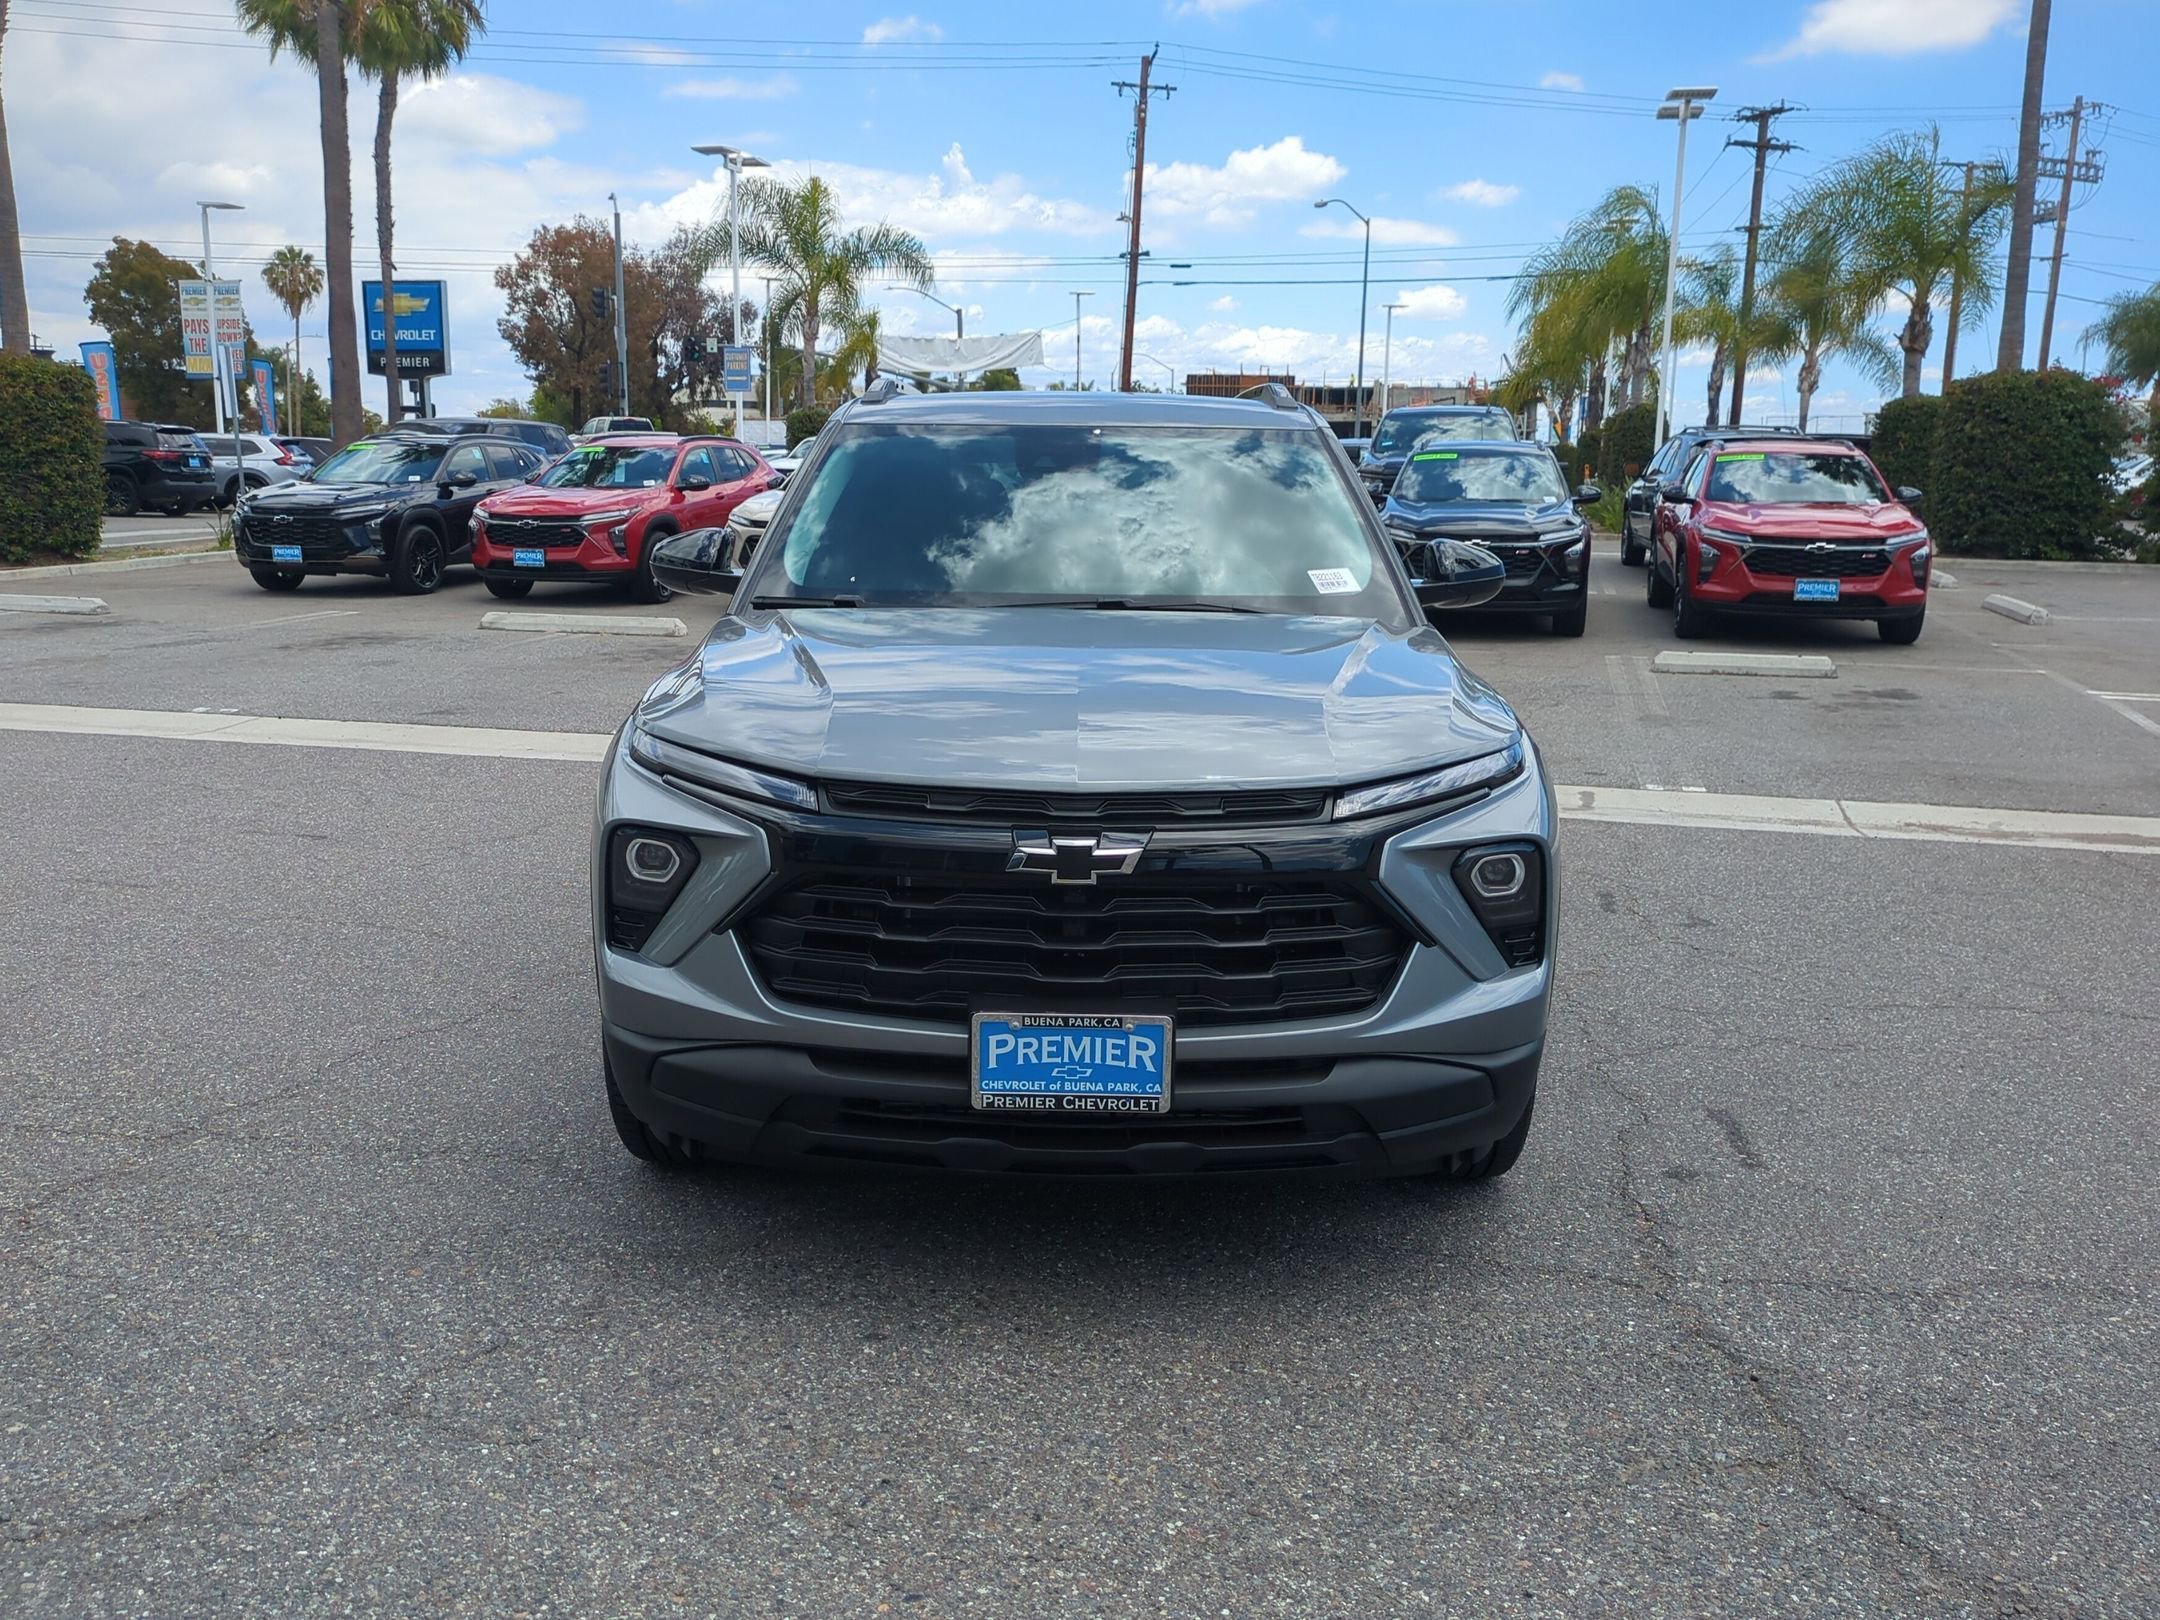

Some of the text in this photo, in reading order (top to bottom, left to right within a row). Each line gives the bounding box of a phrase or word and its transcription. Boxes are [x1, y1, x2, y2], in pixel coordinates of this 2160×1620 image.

[184, 319, 209, 334] PAYS
[216, 319, 241, 330] UPSIDE
[371, 329, 436, 341] CHVROLET
[189, 337, 207, 353] THE
[380, 357, 430, 367] PEMIER
[1797, 583, 1837, 593] PREMIER
[1024, 1017, 1064, 1027] BUENA
[987, 1033, 1157, 1073] PREMIER
[981, 1080, 1162, 1094] CHEVROLET of BUENA PARK, CA
[982, 1094, 1159, 1111] PREMIER CHEVROLET
